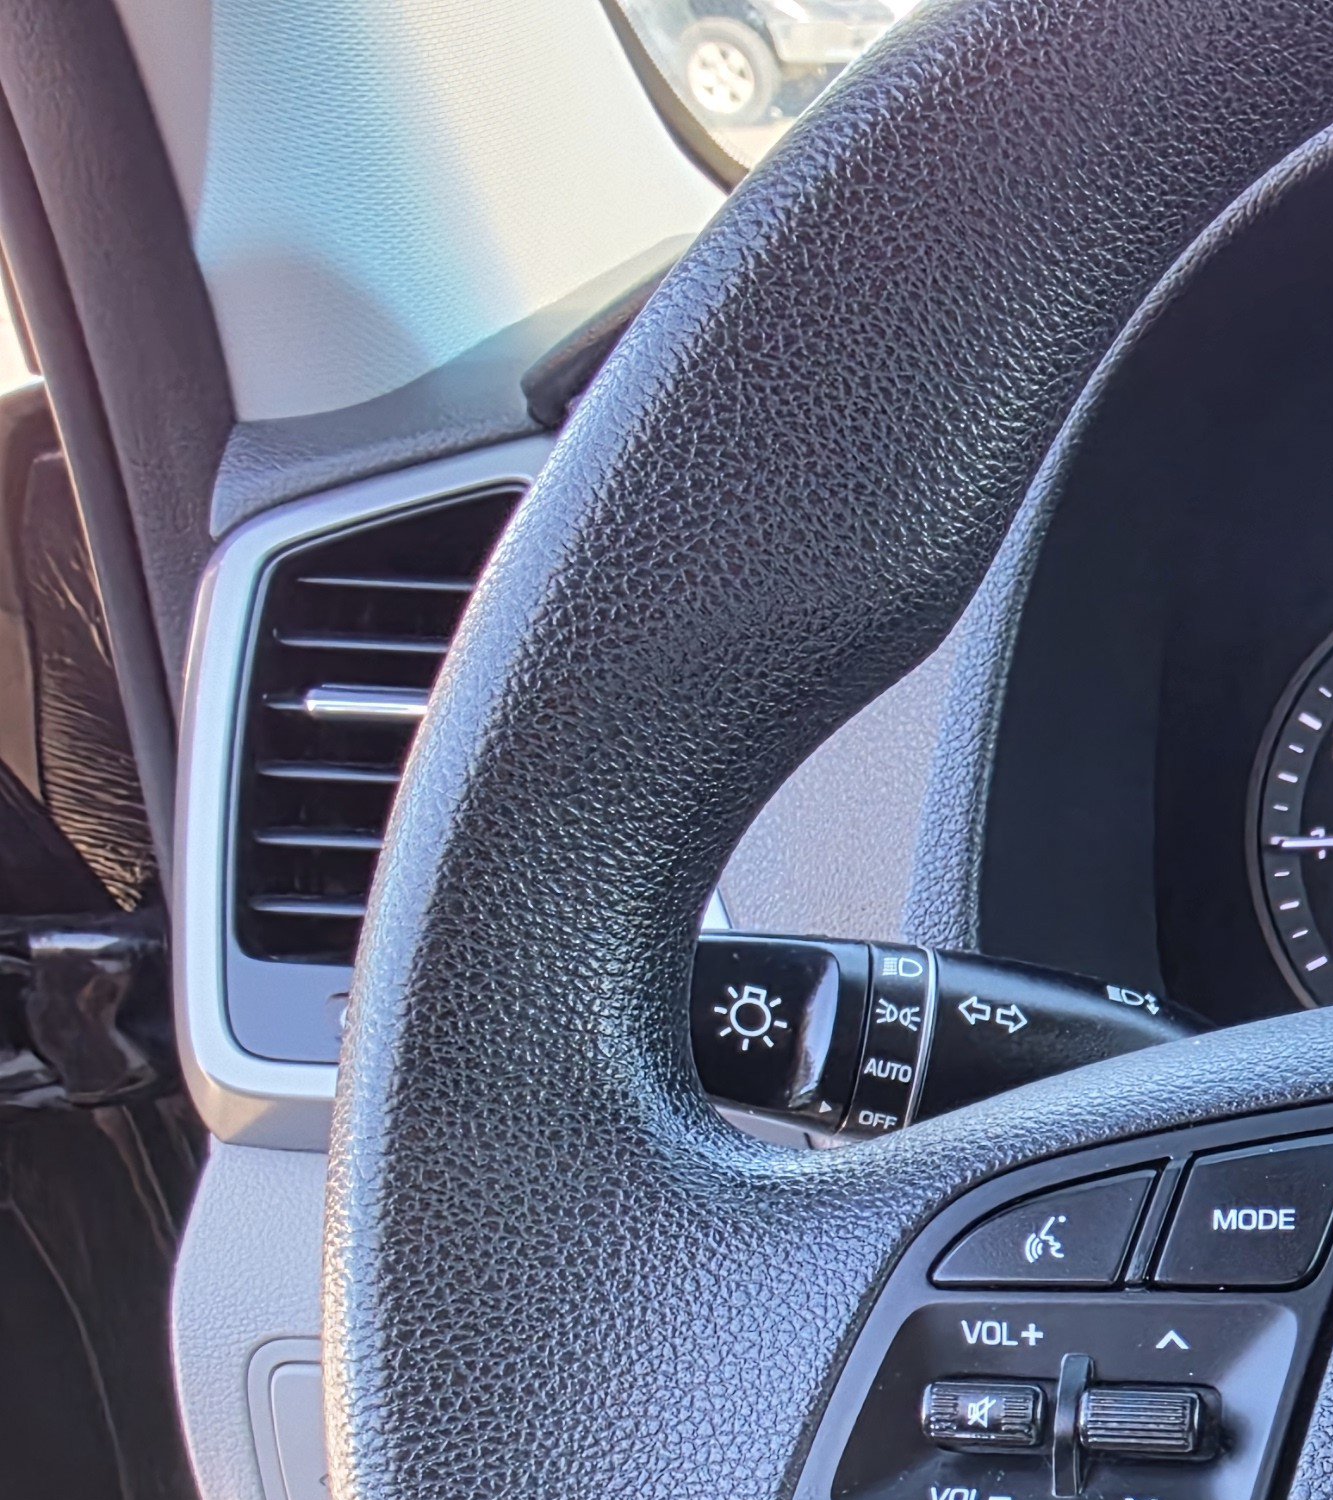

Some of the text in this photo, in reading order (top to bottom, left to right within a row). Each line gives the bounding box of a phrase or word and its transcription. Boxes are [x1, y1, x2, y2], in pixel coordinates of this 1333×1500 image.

[864, 1058, 912, 1083] AUTO
[858, 1110, 898, 1129] OFF
[1212, 1208, 1296, 1230] MODE
[961, 1319, 1044, 1346] VOL+
